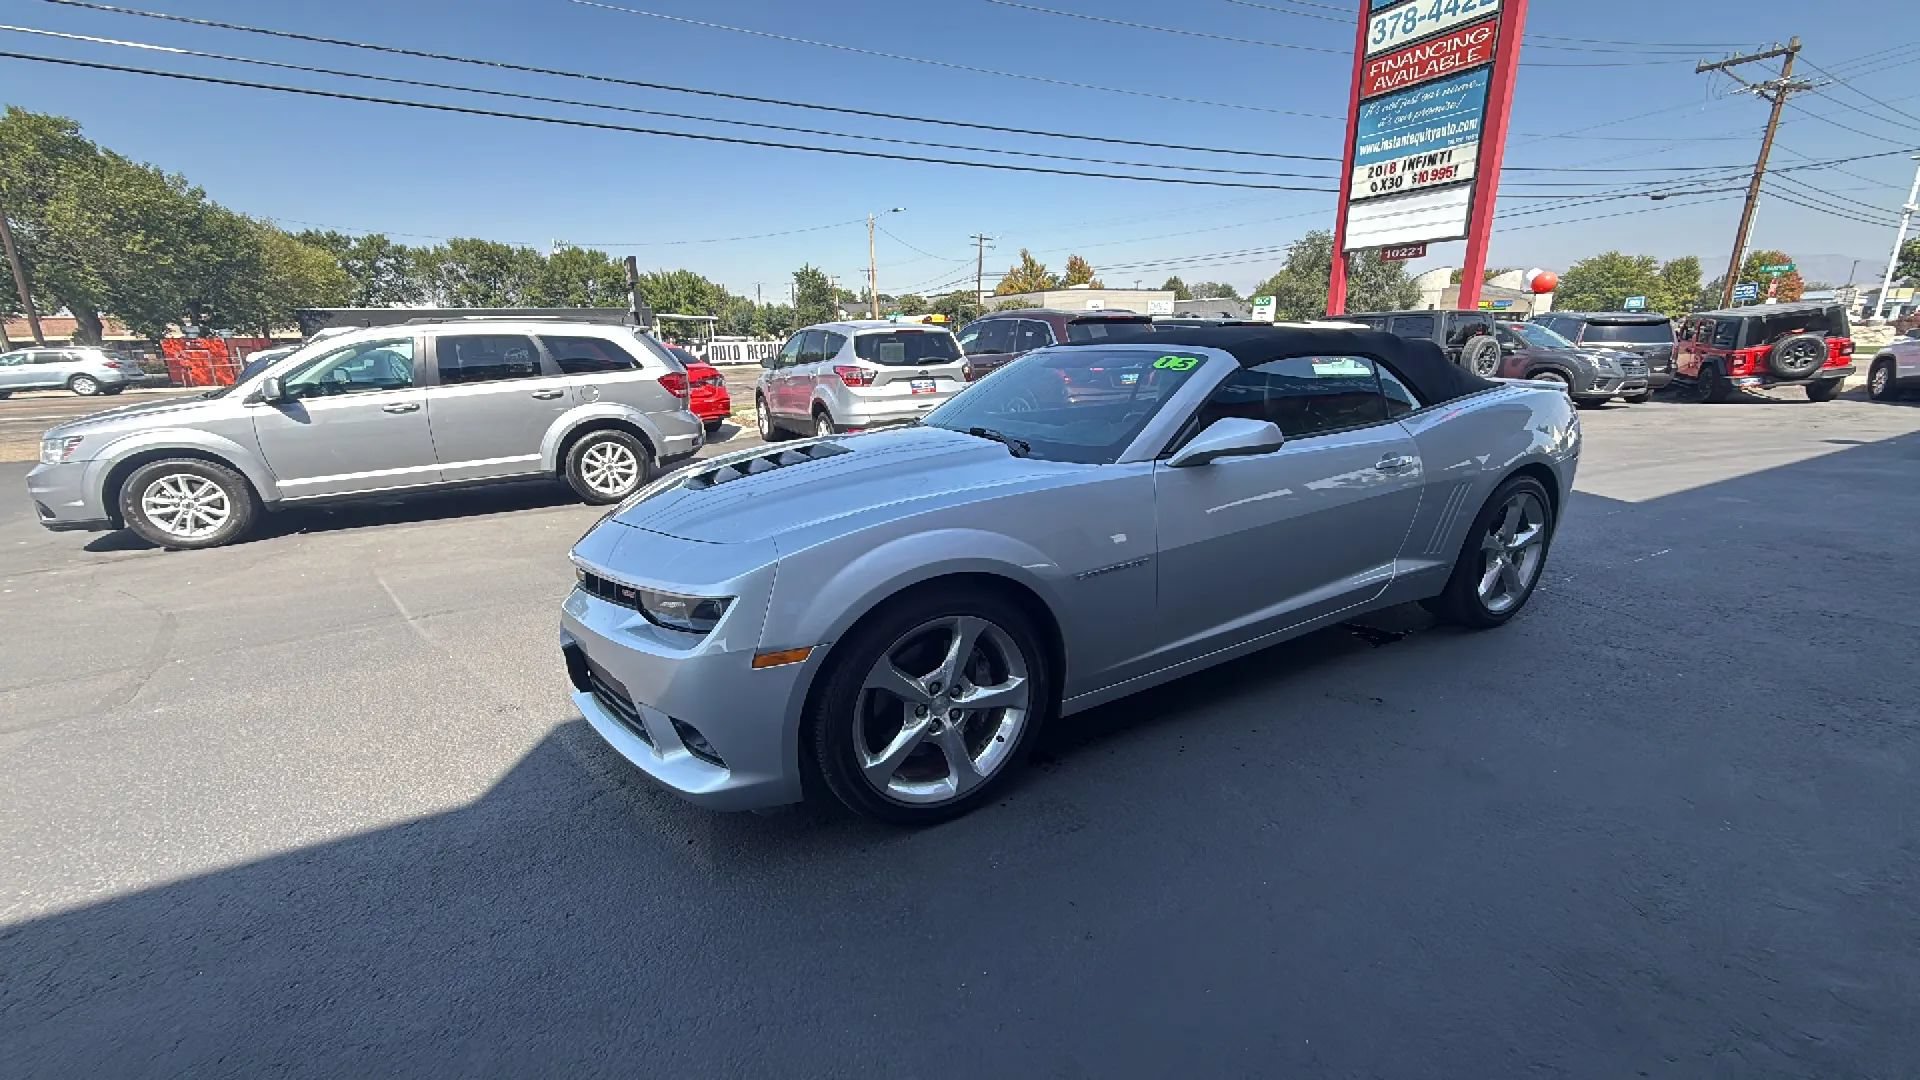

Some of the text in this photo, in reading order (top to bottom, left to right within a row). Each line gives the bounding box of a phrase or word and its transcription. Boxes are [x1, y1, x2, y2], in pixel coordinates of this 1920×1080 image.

[1372, 0, 1495, 45] 378-442
[1369, 27, 1491, 77] FINANCING
[1373, 46, 1482, 90] AVAILABLE
[1360, 117, 1478, 157] www.instantequityauto.com
[1368, 150, 1453, 178] 2018 INFINITI
[1385, 245, 1423, 259] 10221
[711, 345, 740, 361] AUTO
